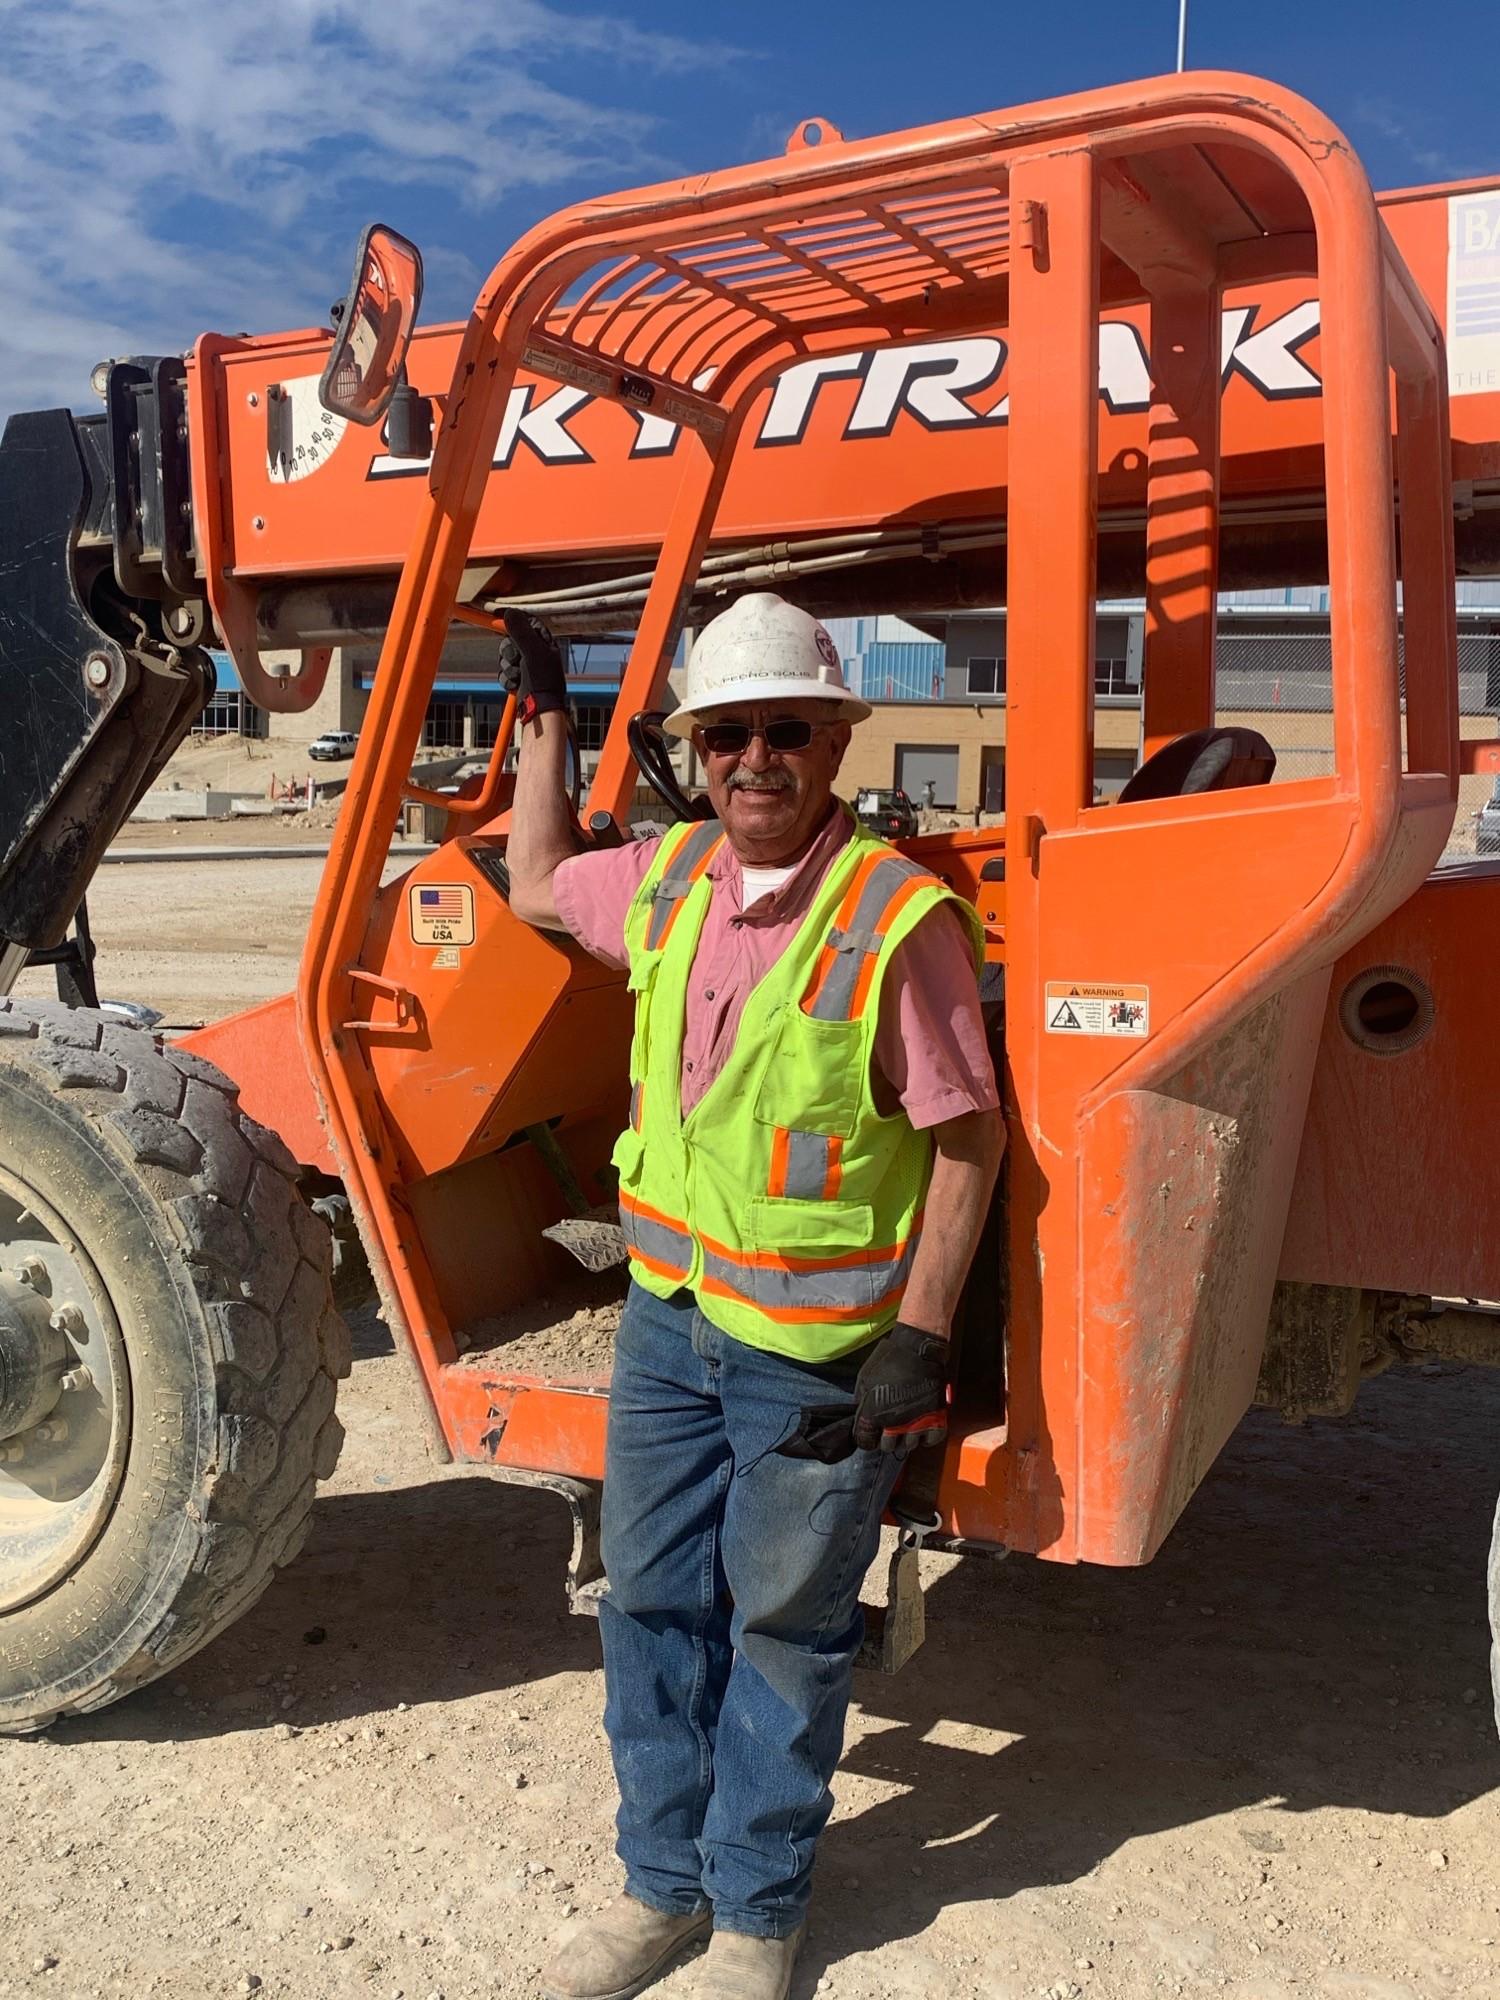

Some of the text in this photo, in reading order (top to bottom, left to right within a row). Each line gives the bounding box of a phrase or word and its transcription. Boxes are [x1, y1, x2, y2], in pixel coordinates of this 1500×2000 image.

[1454, 369, 1496, 389] THE
[366, 298, 1322, 482] KYTRK
[321, 413, 333, 424] 60
[311, 431, 322, 444] 40
[321, 427, 334, 441] 50
[296, 445, 306, 460] 20
[307, 446, 319, 461] 30
[289, 458, 299, 472] 10
[432, 930, 453, 940] USA
[1082, 987, 1125, 997] WARNING
